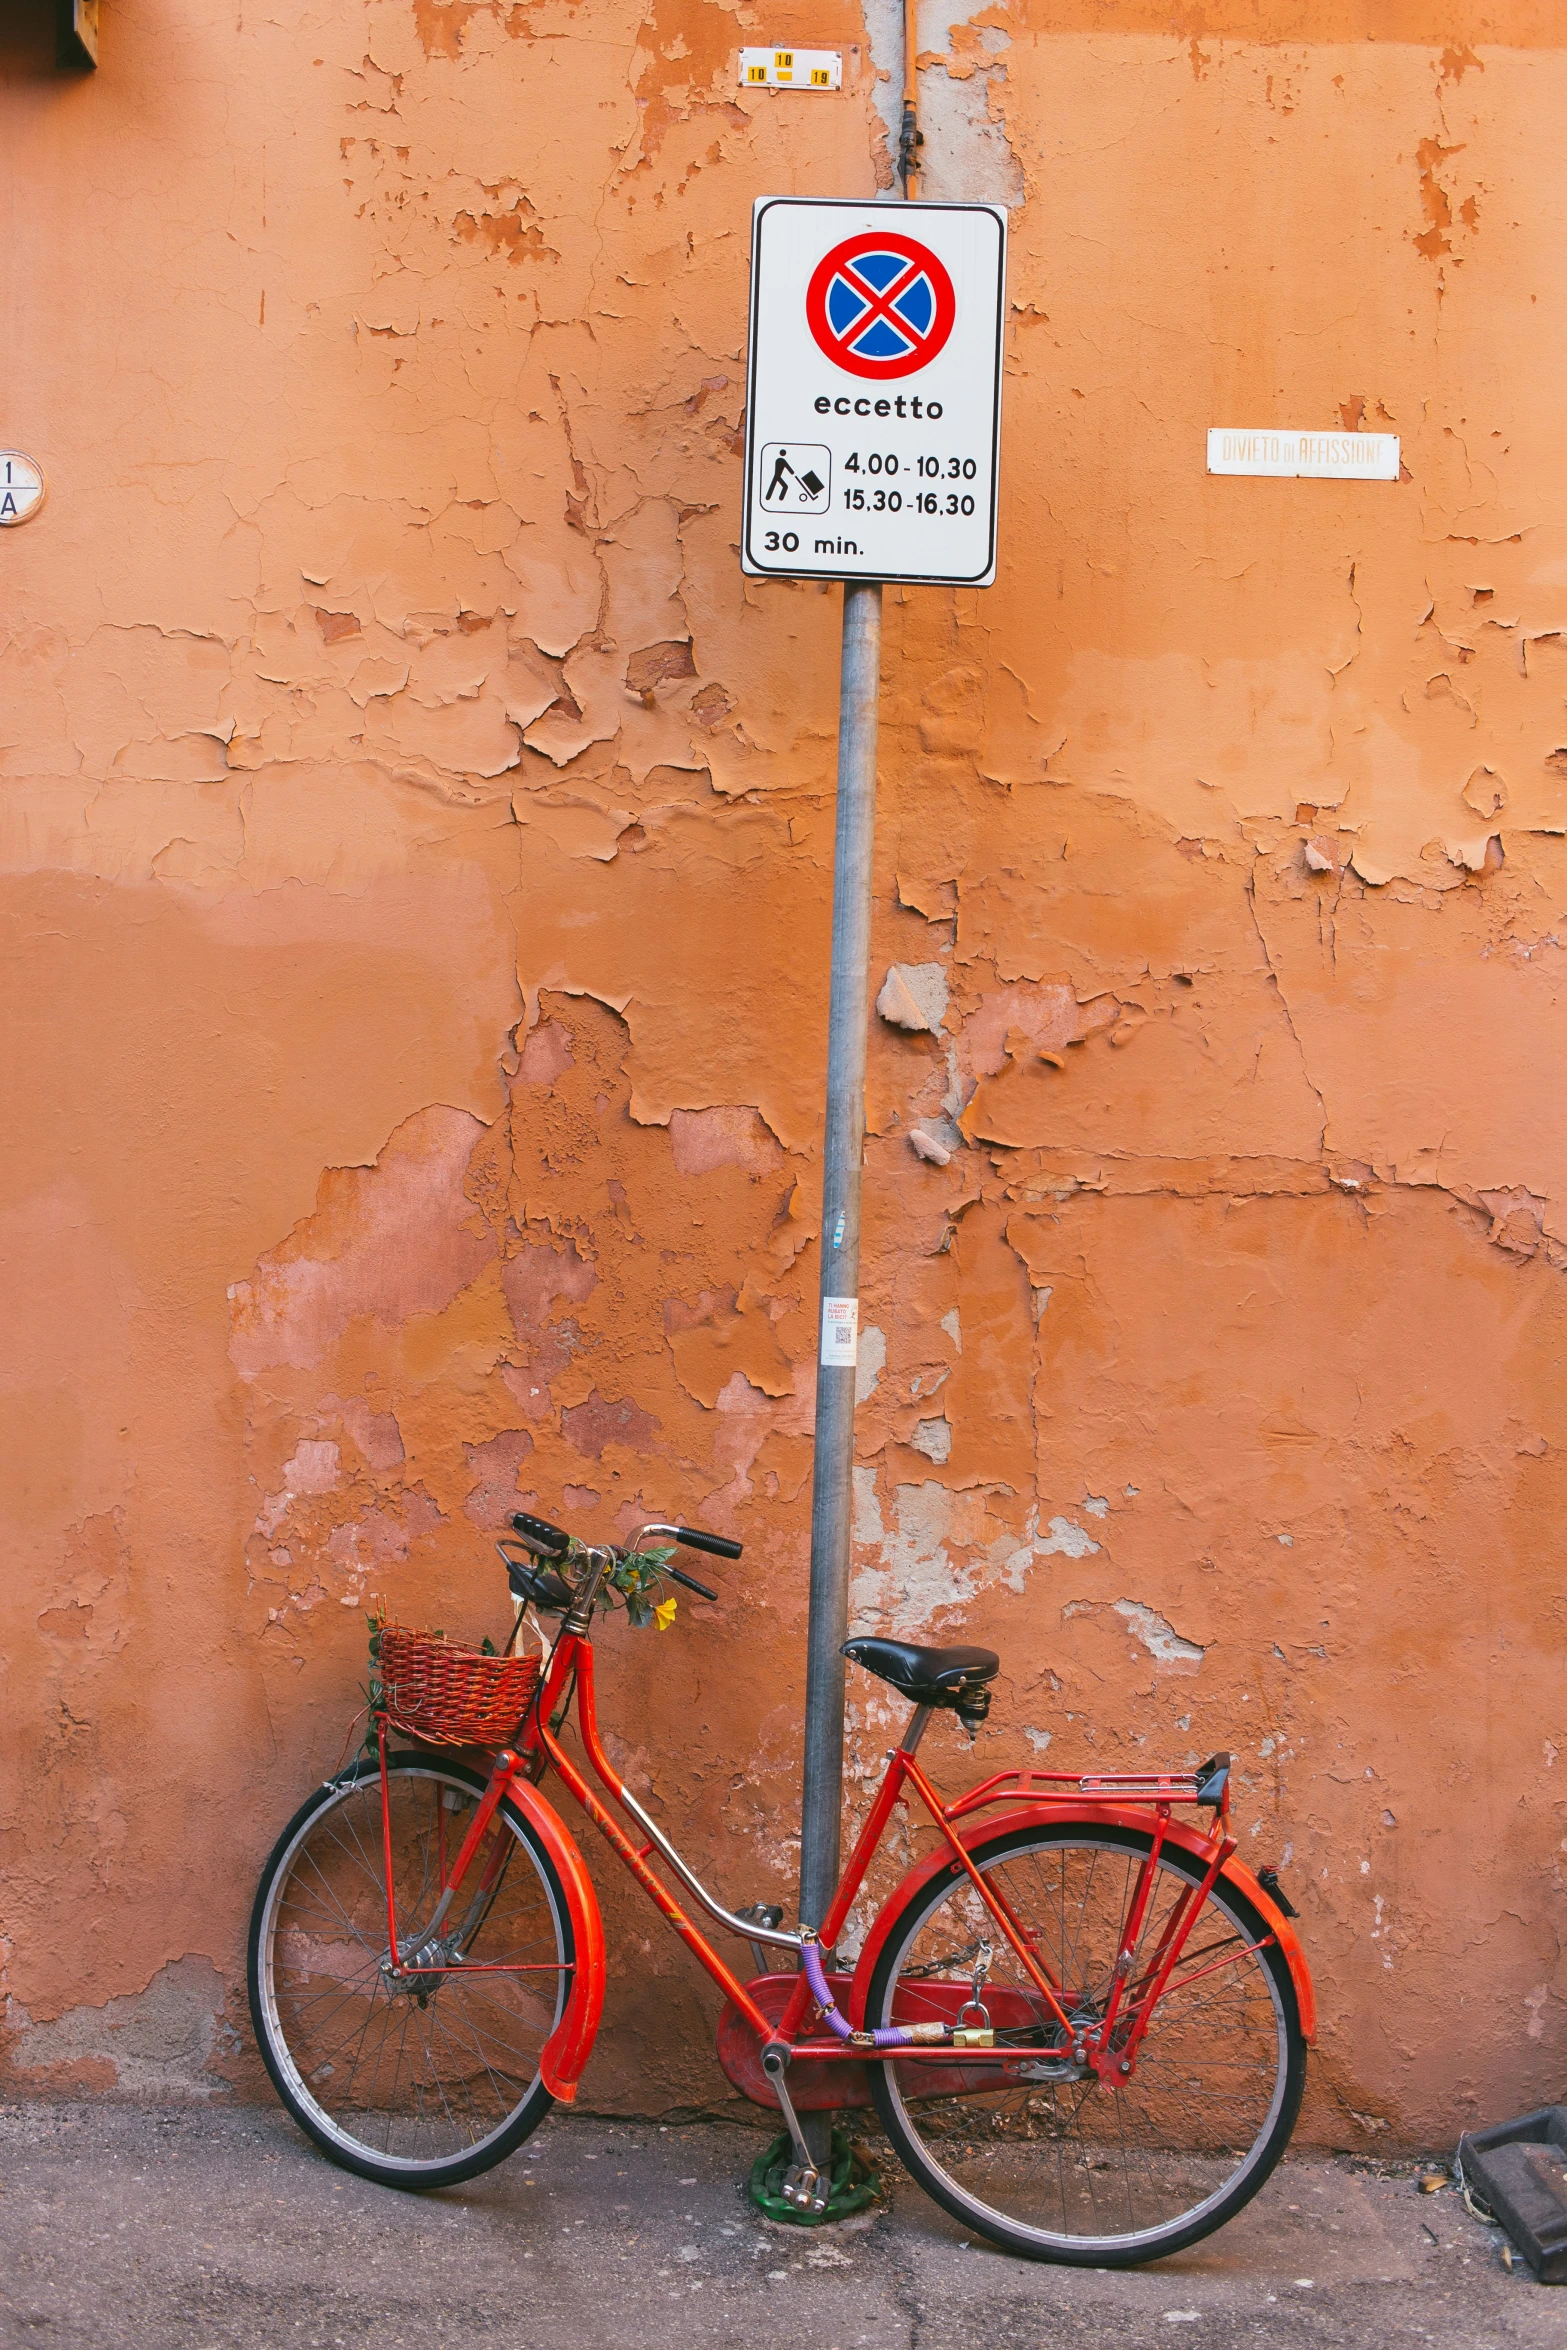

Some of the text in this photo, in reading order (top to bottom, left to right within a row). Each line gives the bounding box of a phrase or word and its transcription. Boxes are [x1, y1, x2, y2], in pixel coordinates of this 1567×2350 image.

[778, 54, 792, 66] 10
[751, 68, 765, 80] 10
[814, 71, 828, 84] 19
[814, 395, 943, 419] eccetto
[1222, 435, 1280, 462] DIVIETO
[1299, 437, 1384, 465] AFFISSIONE
[6, 461, 11, 483] 1
[1, 492, 17, 514] A
[764, 531, 864, 555] 30 min.
